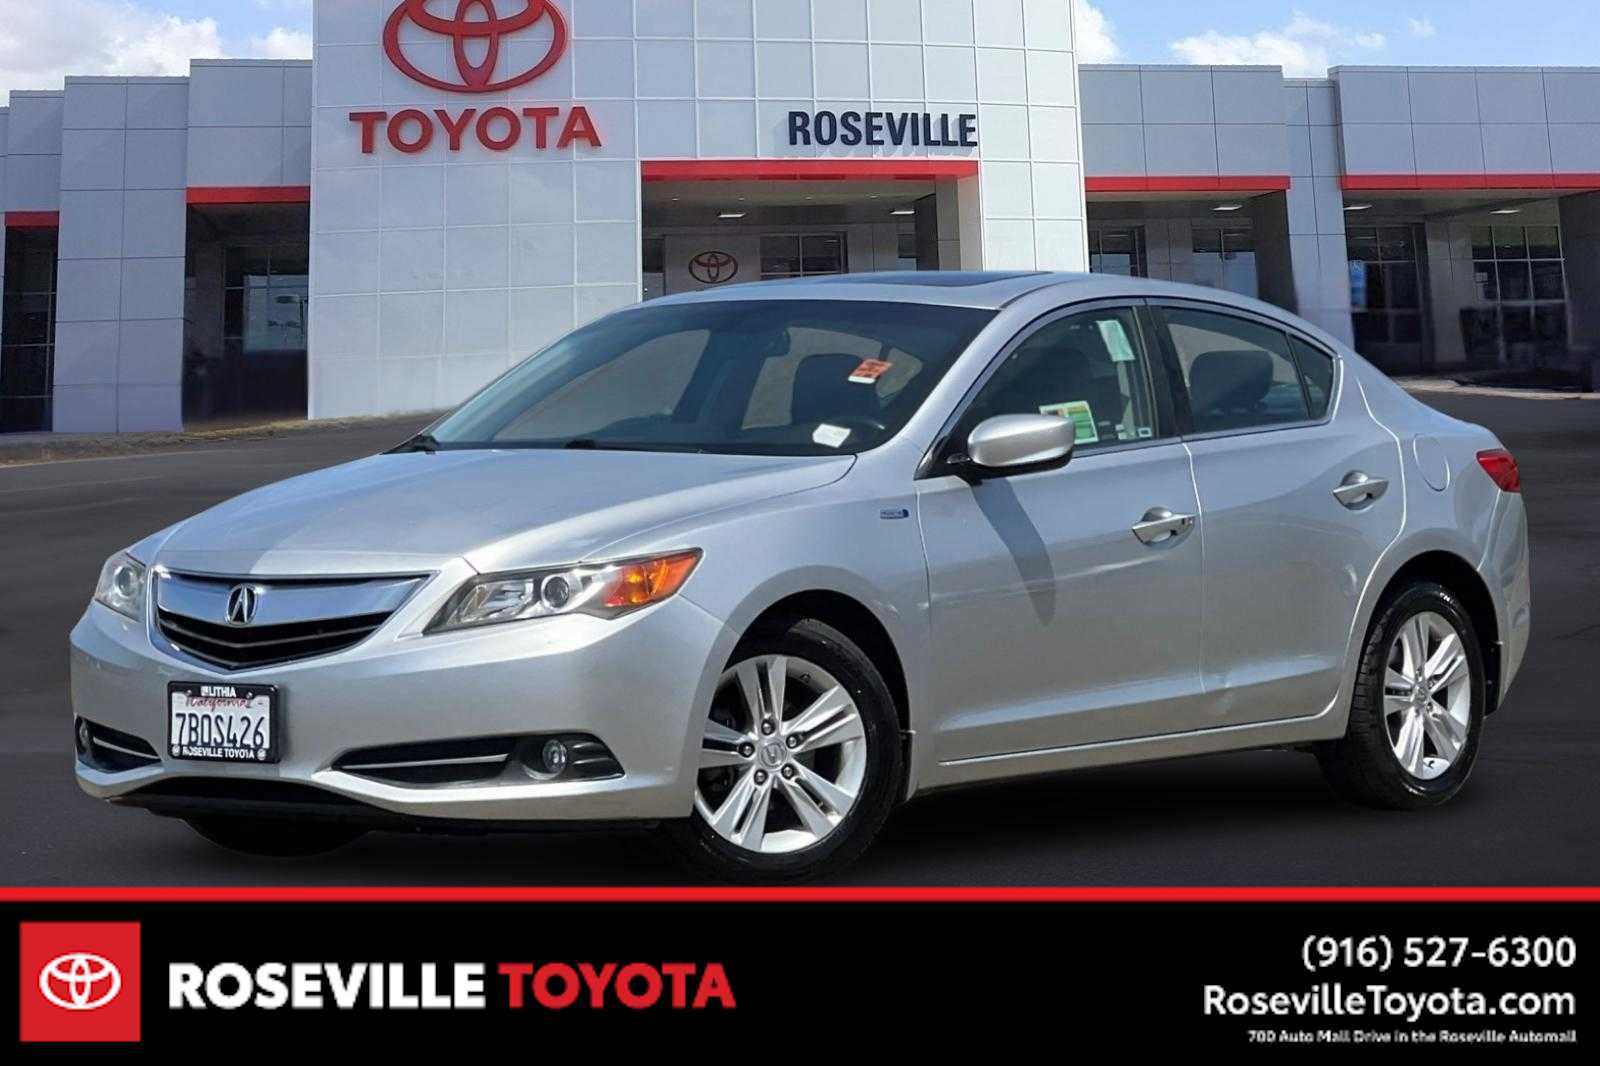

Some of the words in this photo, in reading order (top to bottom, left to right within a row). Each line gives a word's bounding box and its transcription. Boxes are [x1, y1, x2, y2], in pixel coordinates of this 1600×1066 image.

[349, 106, 602, 154] TOYOTA
[788, 110, 978, 147] ROSEVILLE
[208, 686, 237, 698] LITHIA
[182, 746, 223, 758] ROSEVILLE
[224, 748, 255, 759] TOYOTA
